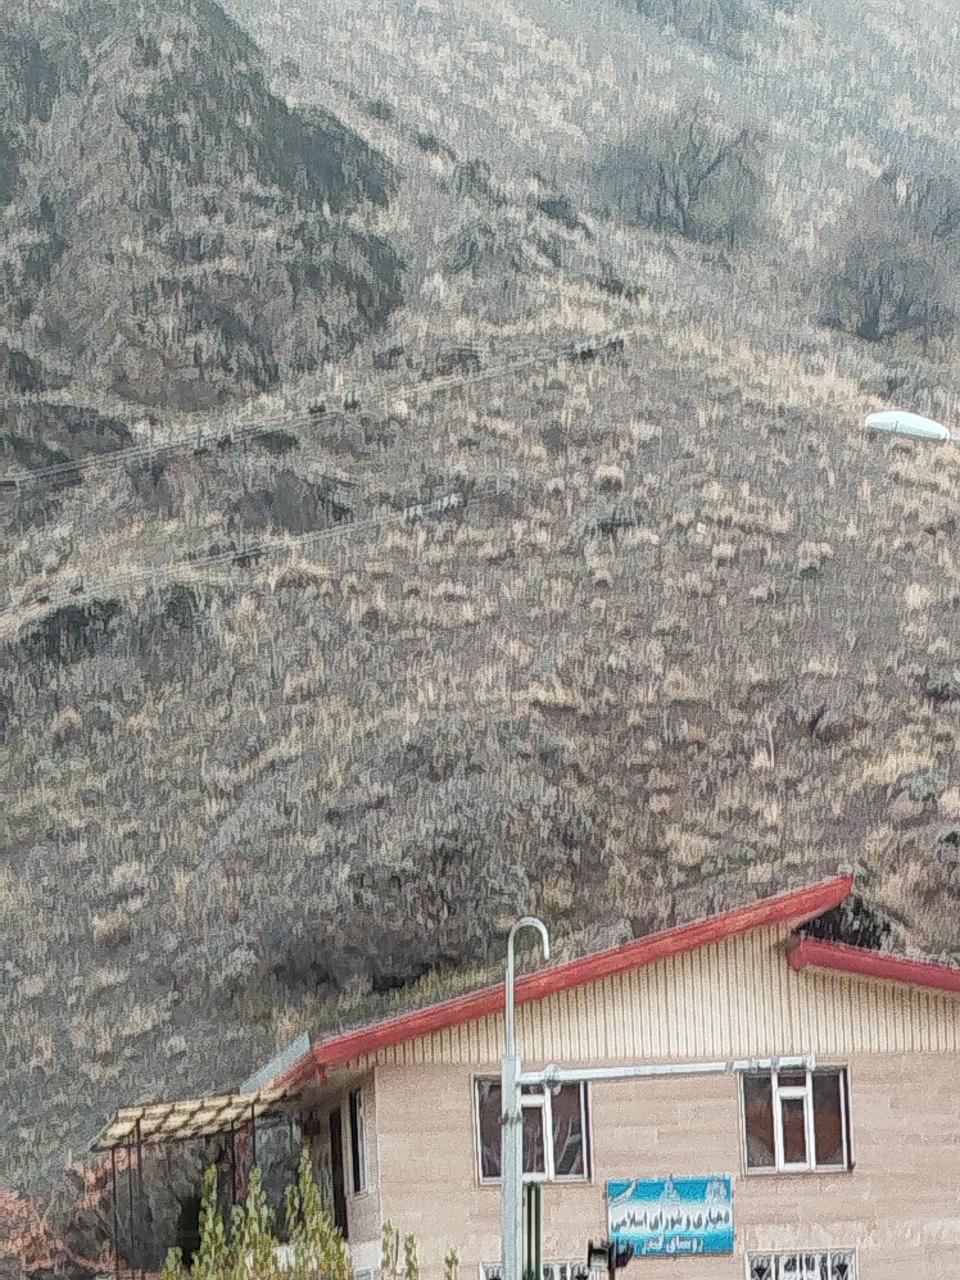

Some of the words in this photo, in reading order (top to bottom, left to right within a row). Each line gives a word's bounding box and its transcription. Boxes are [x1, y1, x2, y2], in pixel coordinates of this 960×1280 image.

[611, 1209, 648, 1232] اسلامی
[649, 1208, 683, 1231] شورای
[684, 1213, 692, 1231] و
